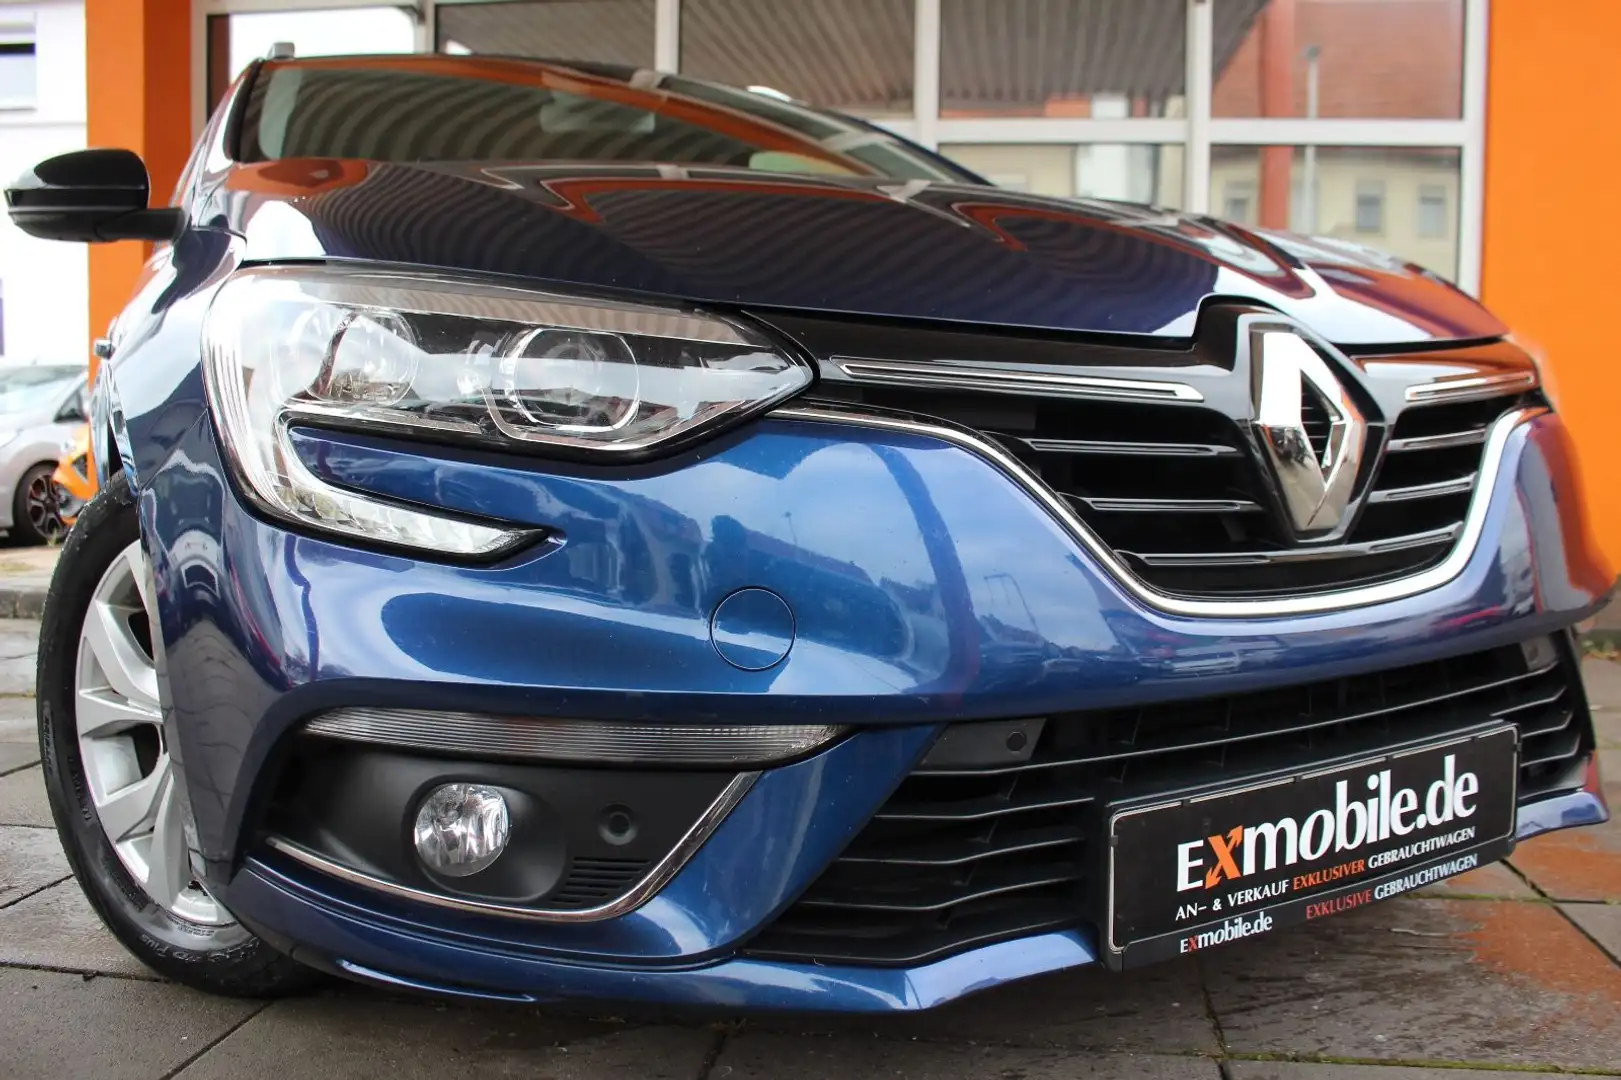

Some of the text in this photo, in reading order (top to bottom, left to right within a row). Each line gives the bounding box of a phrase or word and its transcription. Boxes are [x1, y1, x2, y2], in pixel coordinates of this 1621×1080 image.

[1175, 826, 1476, 921] AN- & VERKAUF EXKLUSIVER GEBRAUCHTWAGEN
[1306, 853, 1478, 919] EXKLUSIVE GEBRAUCHTWAGEN
